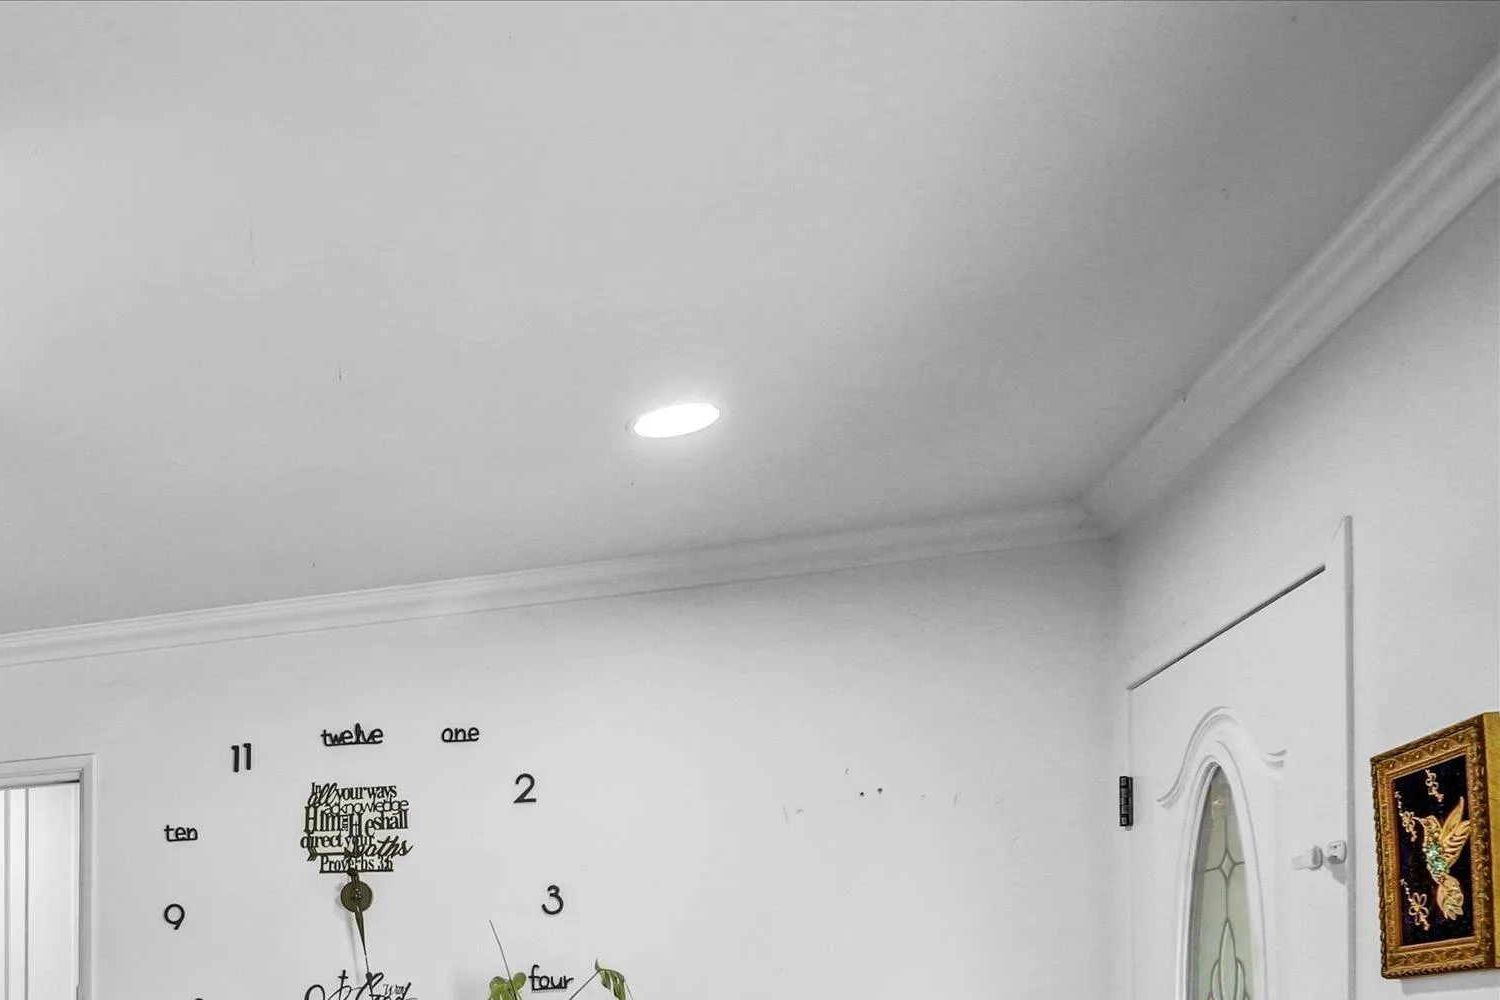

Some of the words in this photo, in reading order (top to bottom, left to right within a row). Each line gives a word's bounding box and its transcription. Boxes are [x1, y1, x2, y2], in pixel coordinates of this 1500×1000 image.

[320, 722, 384, 747] twelve
[441, 726, 480, 743] one
[231, 742, 252, 773] 11
[307, 783, 338, 806] all
[337, 788, 363, 801] your
[365, 786, 398, 801] ways
[513, 773, 537, 804] 2
[324, 798, 409, 815] acknowledge
[163, 824, 199, 843] ten
[304, 806, 341, 833] Him
[348, 812, 375, 838] He
[374, 808, 409, 830] shall
[300, 833, 343, 848] direct
[541, 884, 564, 916] 3
[163, 903, 186, 931] 9
[528, 964, 575, 991] four
